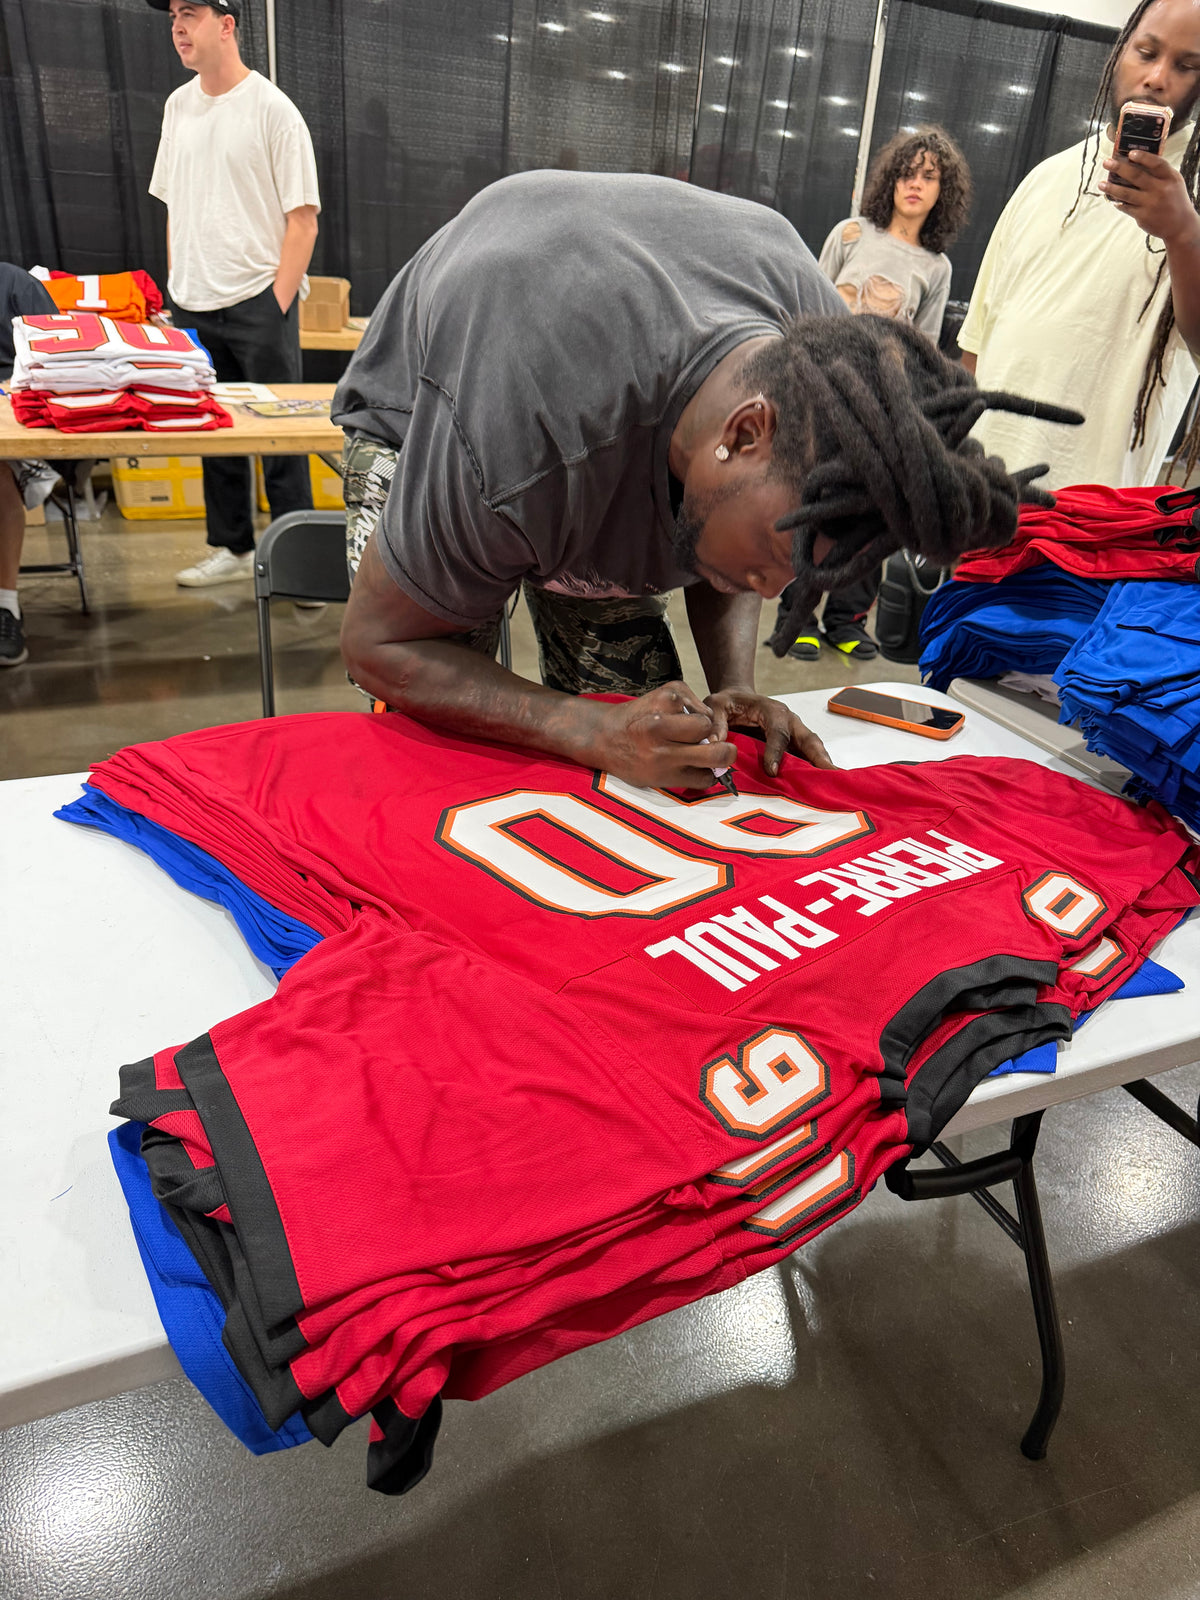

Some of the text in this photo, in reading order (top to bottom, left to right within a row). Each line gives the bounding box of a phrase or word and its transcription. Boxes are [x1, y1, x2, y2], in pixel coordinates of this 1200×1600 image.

[76, 274, 107, 309] 1
[435, 770, 875, 920] 90
[643, 829, 1005, 992] PIERRE-PAUL
